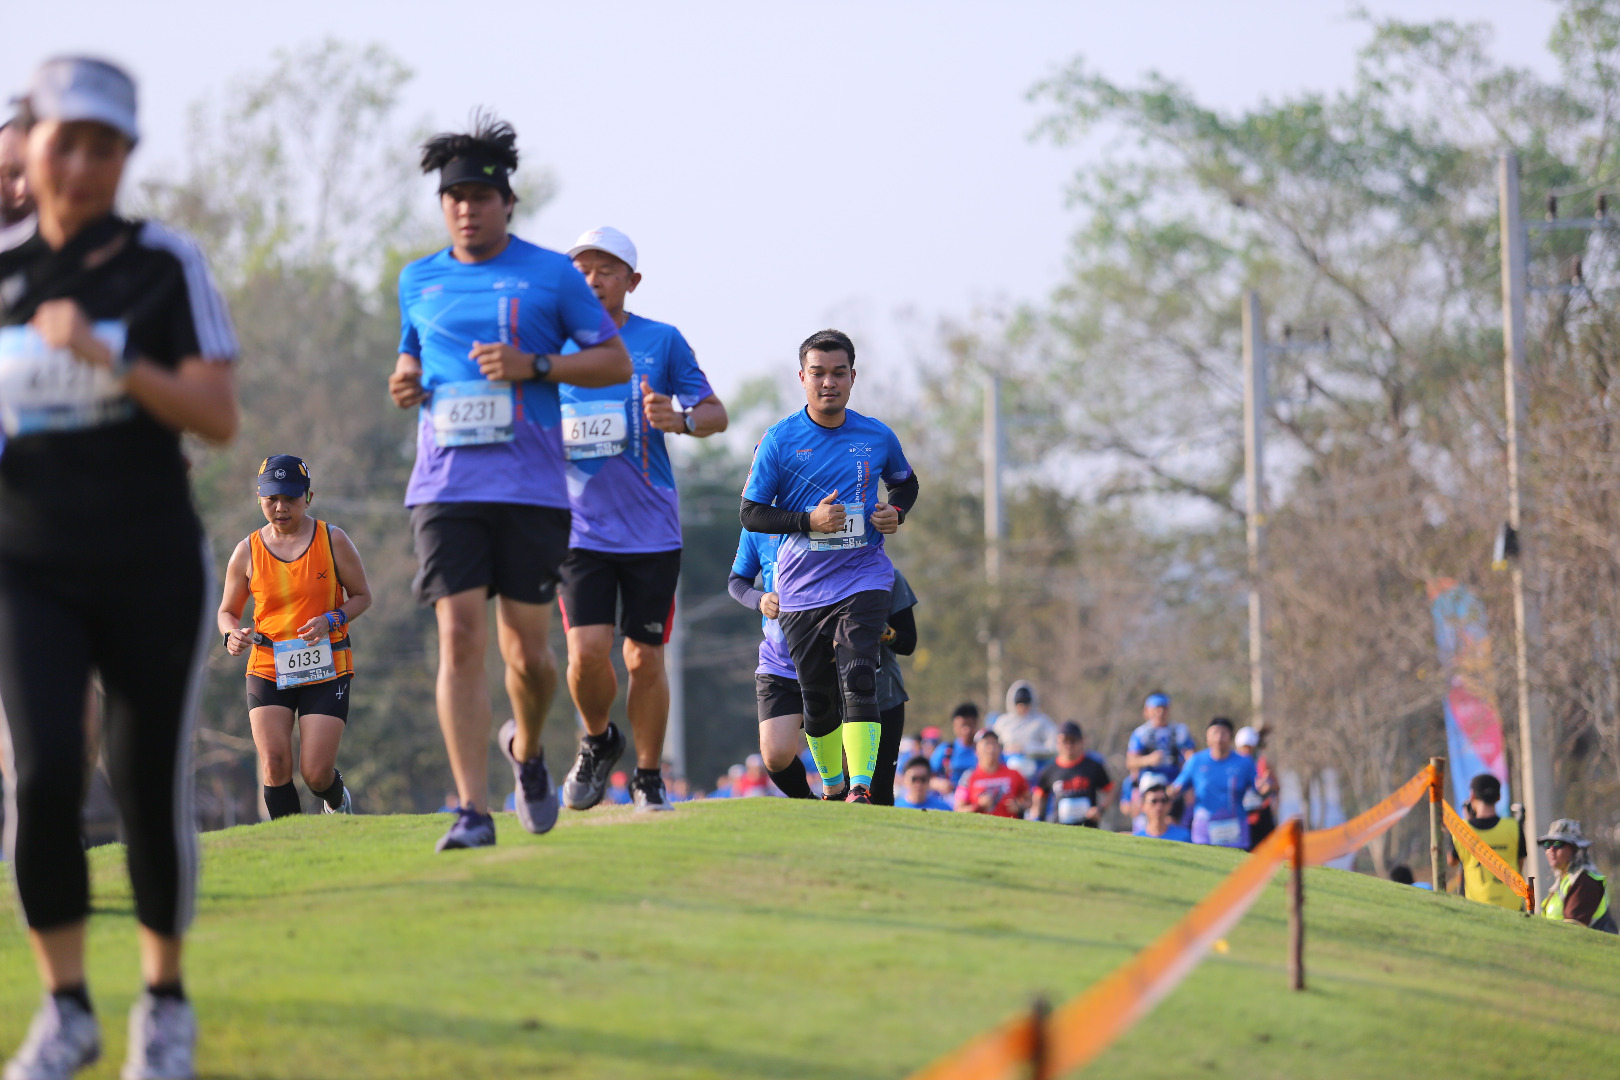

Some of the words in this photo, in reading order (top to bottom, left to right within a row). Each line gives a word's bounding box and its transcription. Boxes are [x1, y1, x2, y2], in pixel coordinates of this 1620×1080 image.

[449, 400, 496, 423] 6231
[571, 418, 611, 440] 6142
[288, 649, 321, 669] 6133
